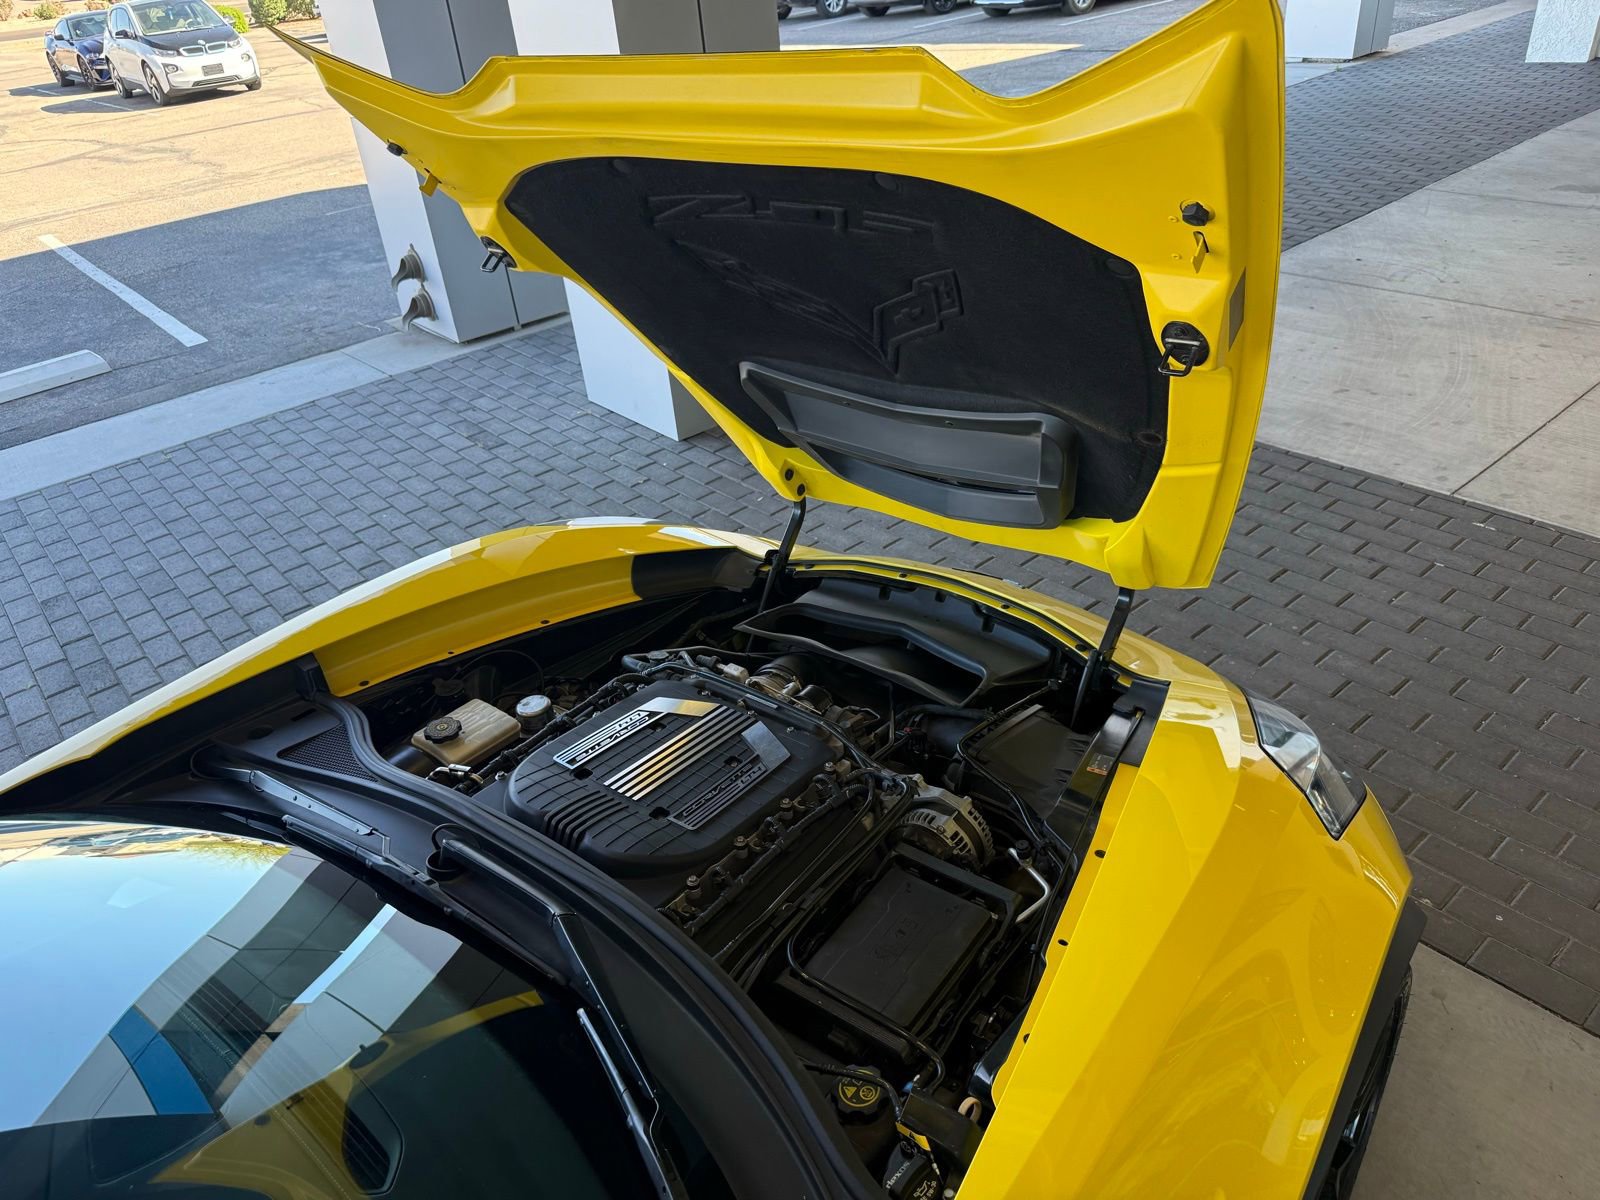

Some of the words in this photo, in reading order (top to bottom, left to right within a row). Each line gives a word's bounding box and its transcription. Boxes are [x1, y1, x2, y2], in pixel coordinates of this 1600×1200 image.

[618, 713, 641, 728] LT4
[575, 716, 649, 762] CORVETTE
[683, 763, 753, 816] CORVETTE
[741, 766, 762, 784] LT4
